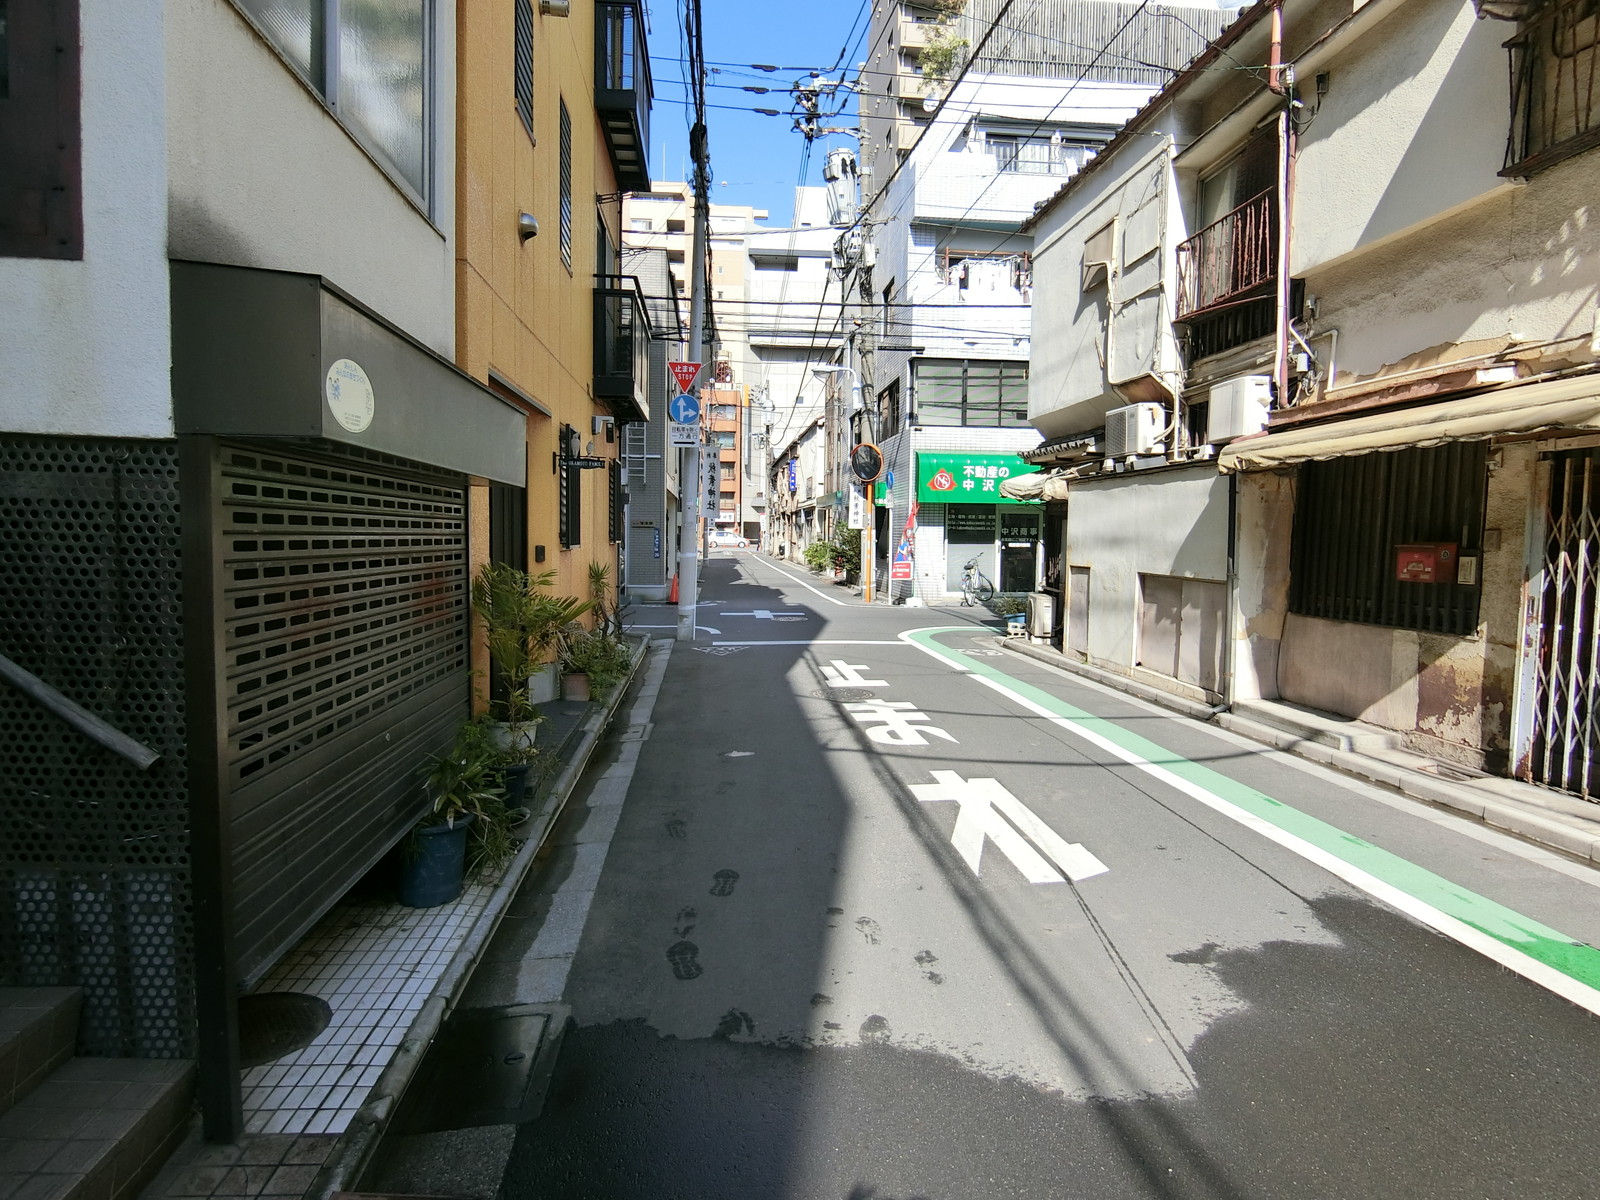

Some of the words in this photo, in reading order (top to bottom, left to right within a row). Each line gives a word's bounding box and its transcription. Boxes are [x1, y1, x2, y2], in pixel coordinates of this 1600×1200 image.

[675, 365, 696, 373] 止まれ
[963, 465, 1010, 479] 不動産の
[963, 479, 995, 492] 中沢
[1001, 527, 1038, 536] 中沢商事
[819, 659, 1110, 884] 止まれ
